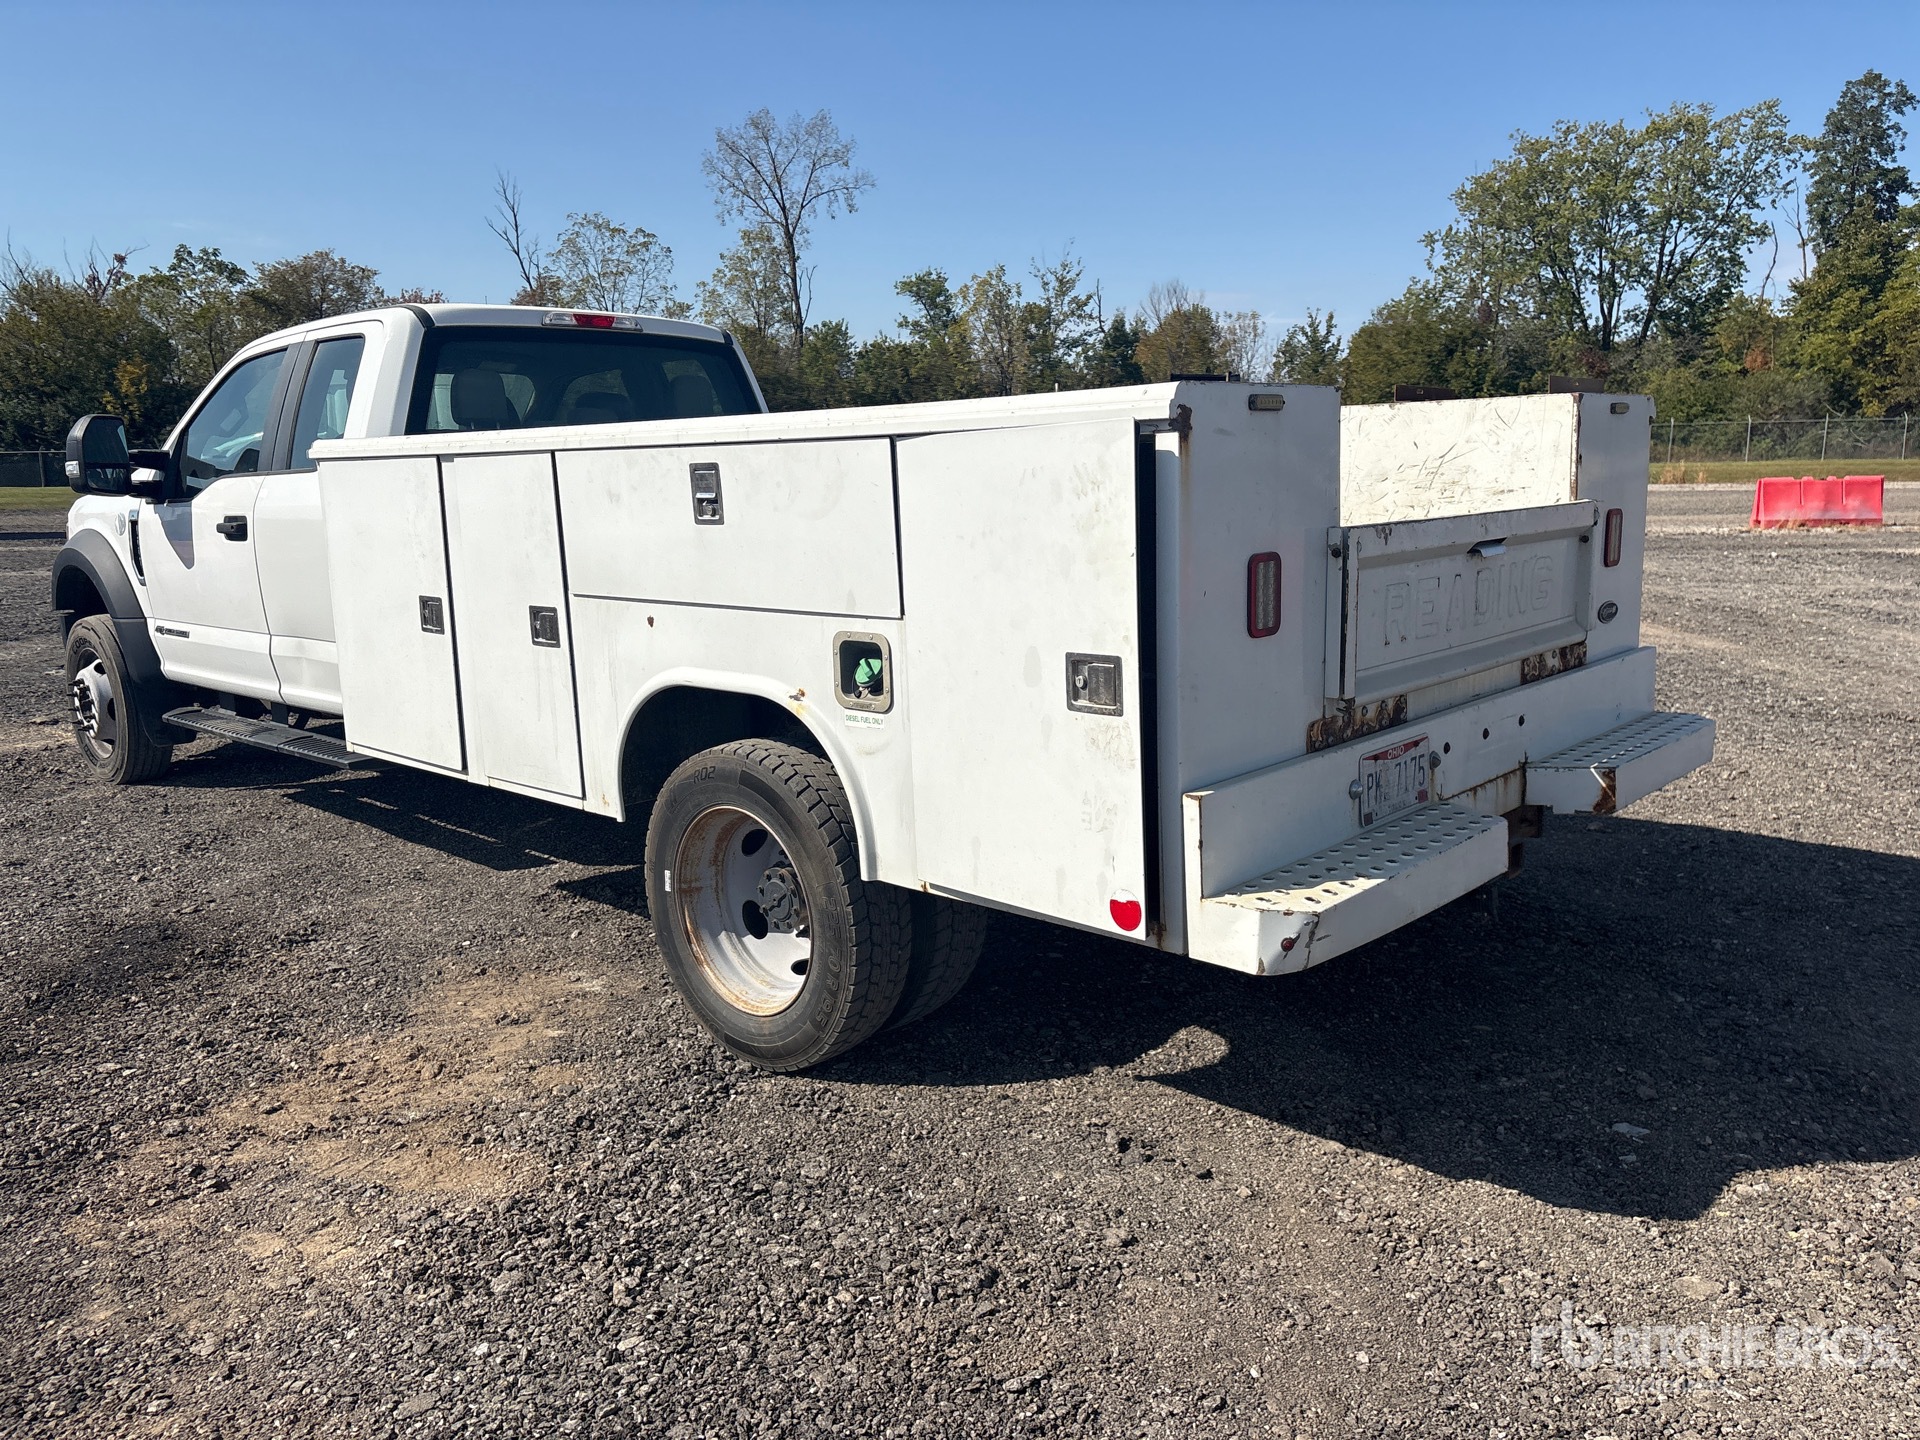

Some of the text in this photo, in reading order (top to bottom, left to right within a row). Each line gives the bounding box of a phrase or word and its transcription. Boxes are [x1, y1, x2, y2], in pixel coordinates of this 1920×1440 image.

[1384, 555, 1554, 647] READING
[845, 714, 883, 725] DIESEL FUEL ONLY
[1387, 745, 1405, 759] OHIO
[1394, 753, 1425, 797] 7175
